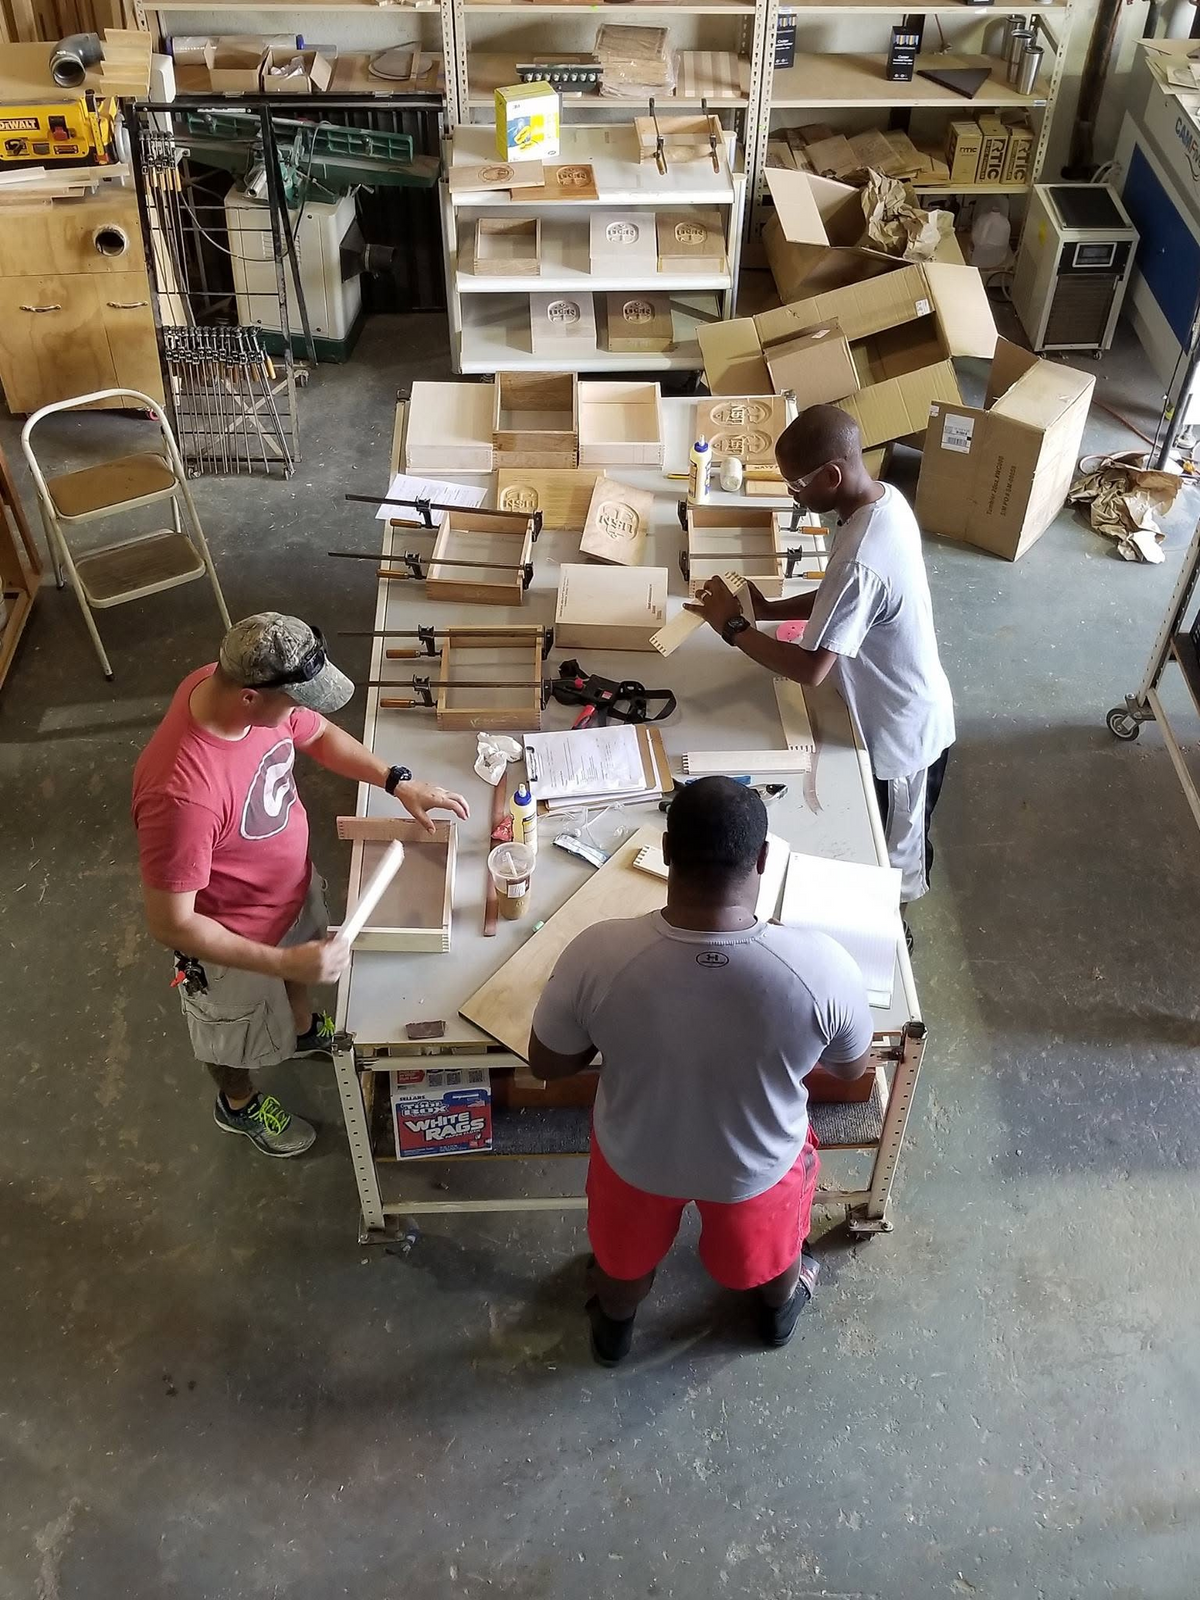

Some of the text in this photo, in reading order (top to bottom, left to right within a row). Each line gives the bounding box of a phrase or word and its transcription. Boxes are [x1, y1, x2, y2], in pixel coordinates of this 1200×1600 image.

[987, 139, 1007, 180] RTIC
[1013, 139, 1032, 180] RTIC
[405, 1112, 470, 1132] WHITE
[425, 1118, 485, 1141] RAGS
